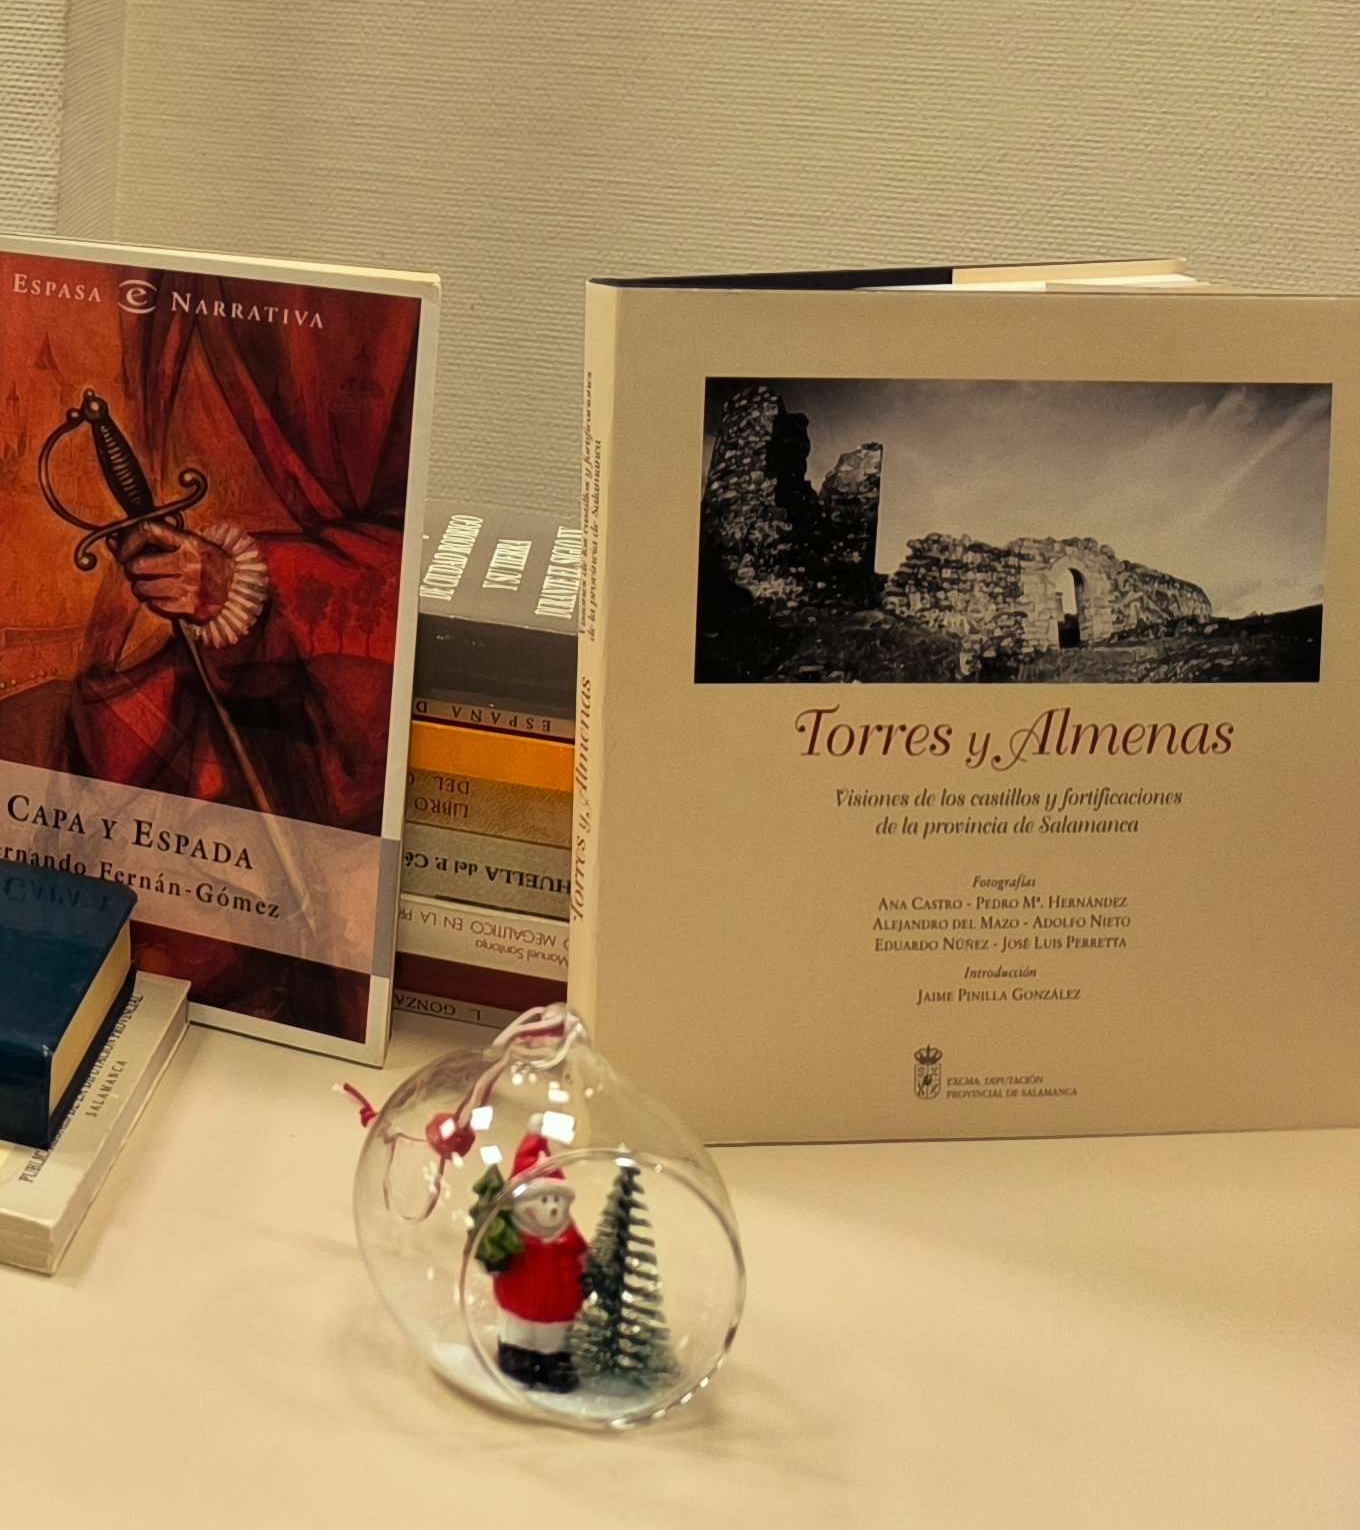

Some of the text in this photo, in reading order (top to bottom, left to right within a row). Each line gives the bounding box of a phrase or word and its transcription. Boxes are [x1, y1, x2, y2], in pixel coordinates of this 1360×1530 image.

[11, 272, 325, 330] ESPASA NARRATIVA
[423, 512, 483, 588] CIUDAD RODRIGO
[490, 536, 531, 570] TIERRA
[534, 575, 580, 619] DURANTE
[451, 705, 551, 730] ESPAÑA
[794, 704, 1234, 771] Torres y Almenas
[433, 774, 470, 795] DEL
[413, 796, 469, 818] LIBRO
[572, 676, 592, 923] Torres Almenas
[835, 787, 1184, 813] Visiones de los castillos y fortificaciones
[7, 793, 254, 871] CAPA Y ESPADA
[875, 815, 1140, 840] de la provincia de Salamanca
[98, 860, 281, 919] Fernán-Gómez
[453, 859, 571, 895] HUELLA del
[972, 874, 1036, 890] Fotografías
[878, 894, 1129, 911] ANA CASTRO PEDRO HERNÁNDEZ
[419, 912, 437, 926] LA
[443, 916, 464, 931] EN
[872, 914, 1132, 933] ALEJANDRO DEL MAZO ADOLFO NIETO
[475, 939, 568, 967] Manuel Santonja
[874, 934, 1128, 954] EDUARDO NÚÑEZ JOSÉ LUIS PERRETTA
[963, 965, 1038, 981] Introducción
[916, 985, 1082, 1007] JAIME PINILLA GONZÁLEZ
[85, 1058, 128, 1118] SALAMANCA
[984, 1074, 1044, 1086] DIPUTACIÓN
[946, 1087, 1078, 1099] PROVINCIAL DE SALAMANCA
